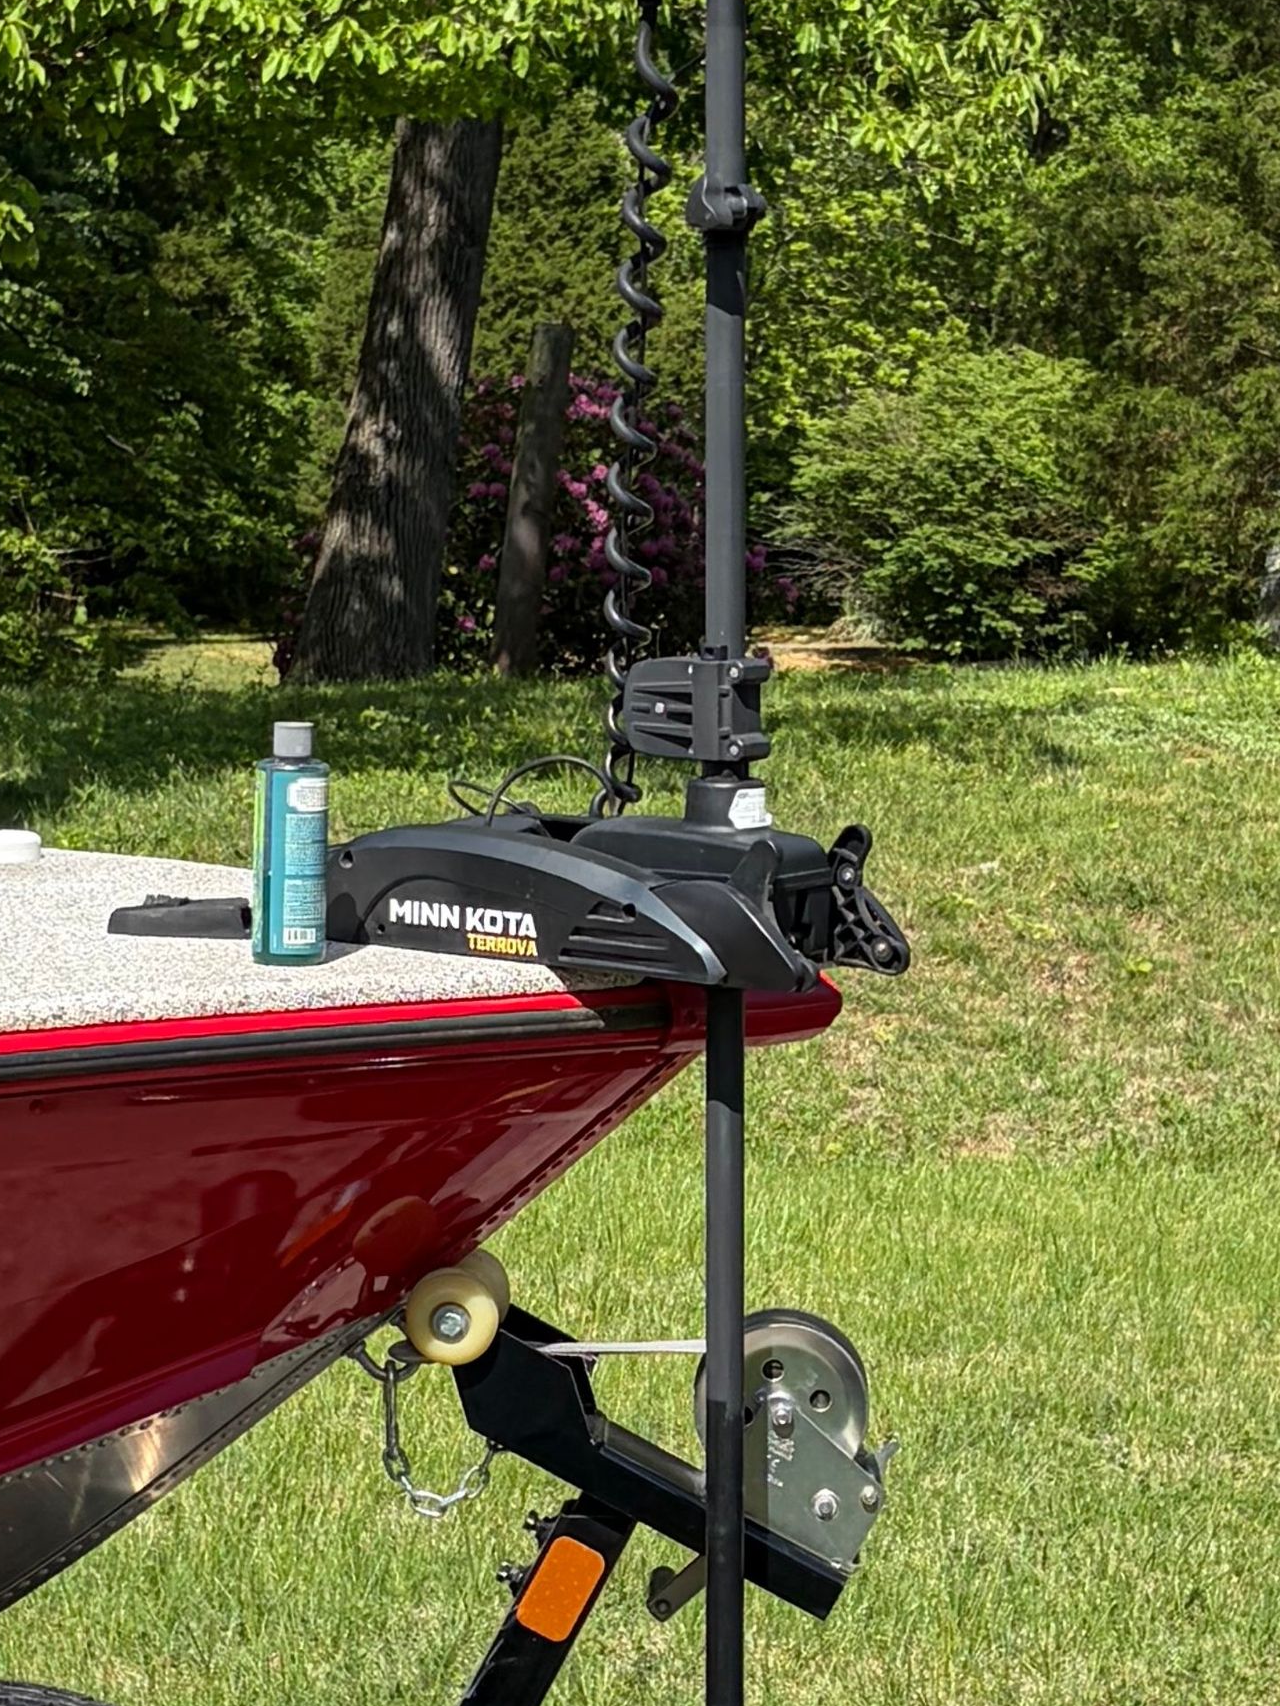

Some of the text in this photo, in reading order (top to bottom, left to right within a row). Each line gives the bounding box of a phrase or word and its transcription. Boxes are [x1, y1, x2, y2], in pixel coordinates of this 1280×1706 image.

[389, 897, 537, 938] MINN KOTA
[466, 932, 538, 957] TERROVA
